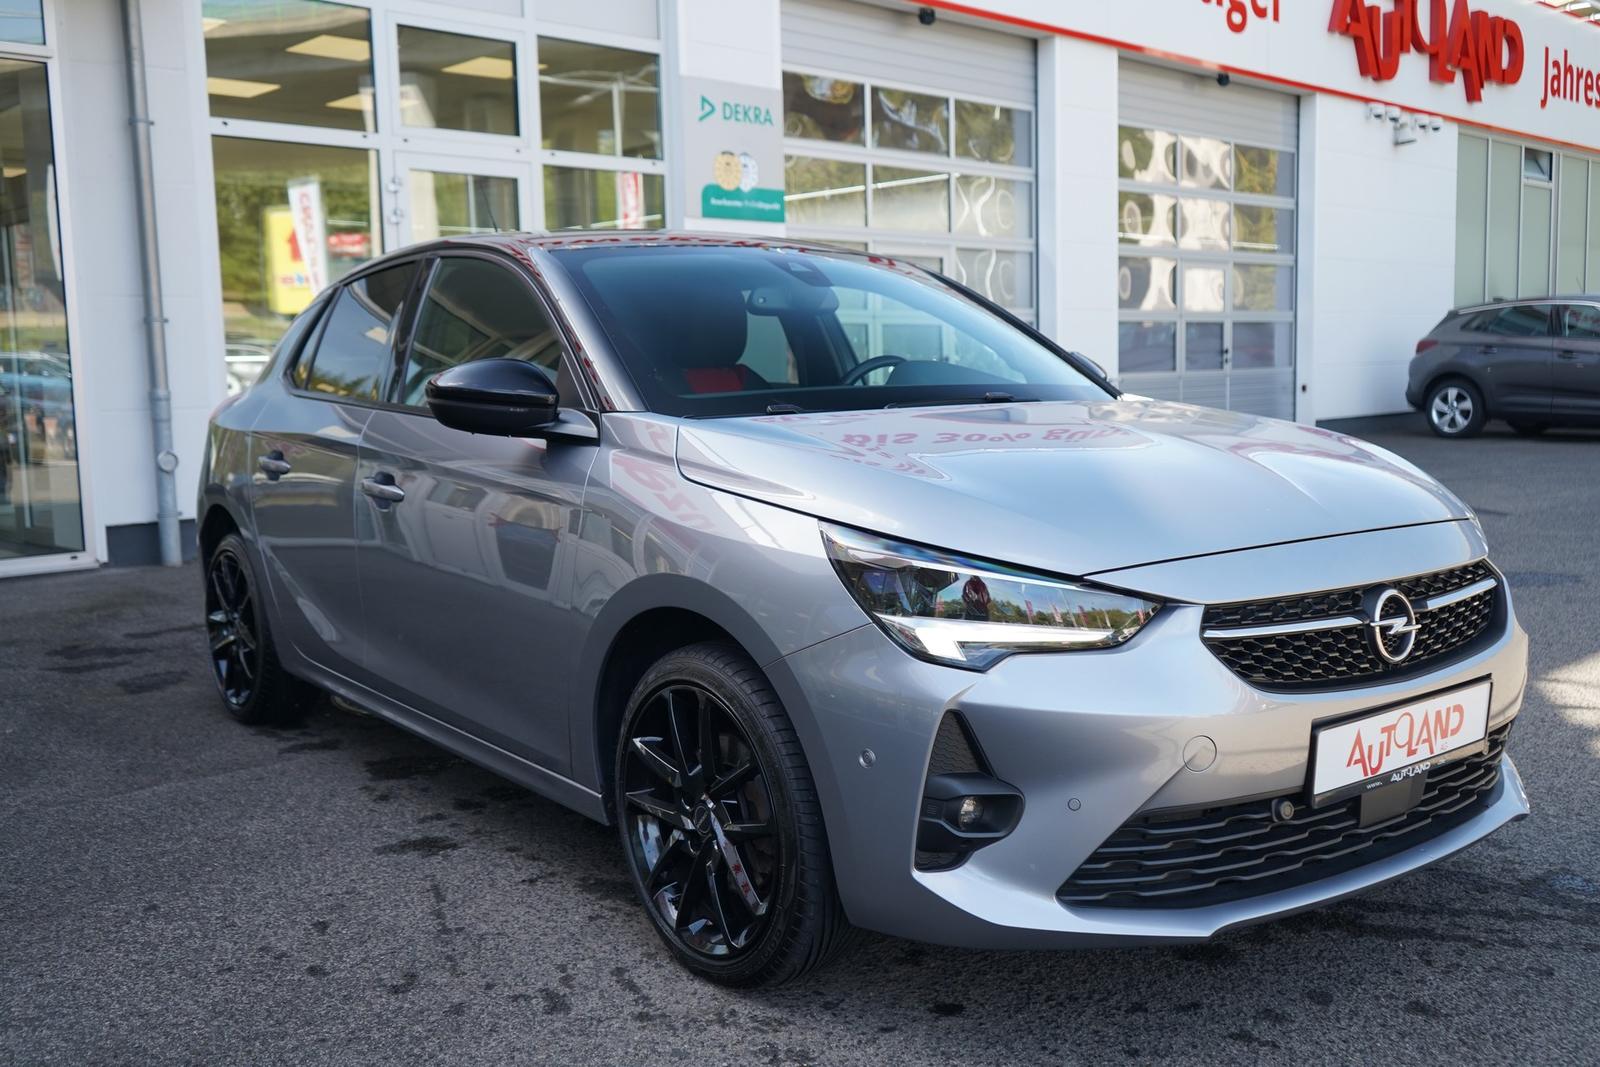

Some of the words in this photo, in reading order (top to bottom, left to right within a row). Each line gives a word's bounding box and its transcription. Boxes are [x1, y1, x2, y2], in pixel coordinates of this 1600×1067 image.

[722, 101, 774, 127] DEKRA
[1346, 703, 1465, 777] AUTOLAND
[1390, 761, 1432, 783] AUTOLAND
